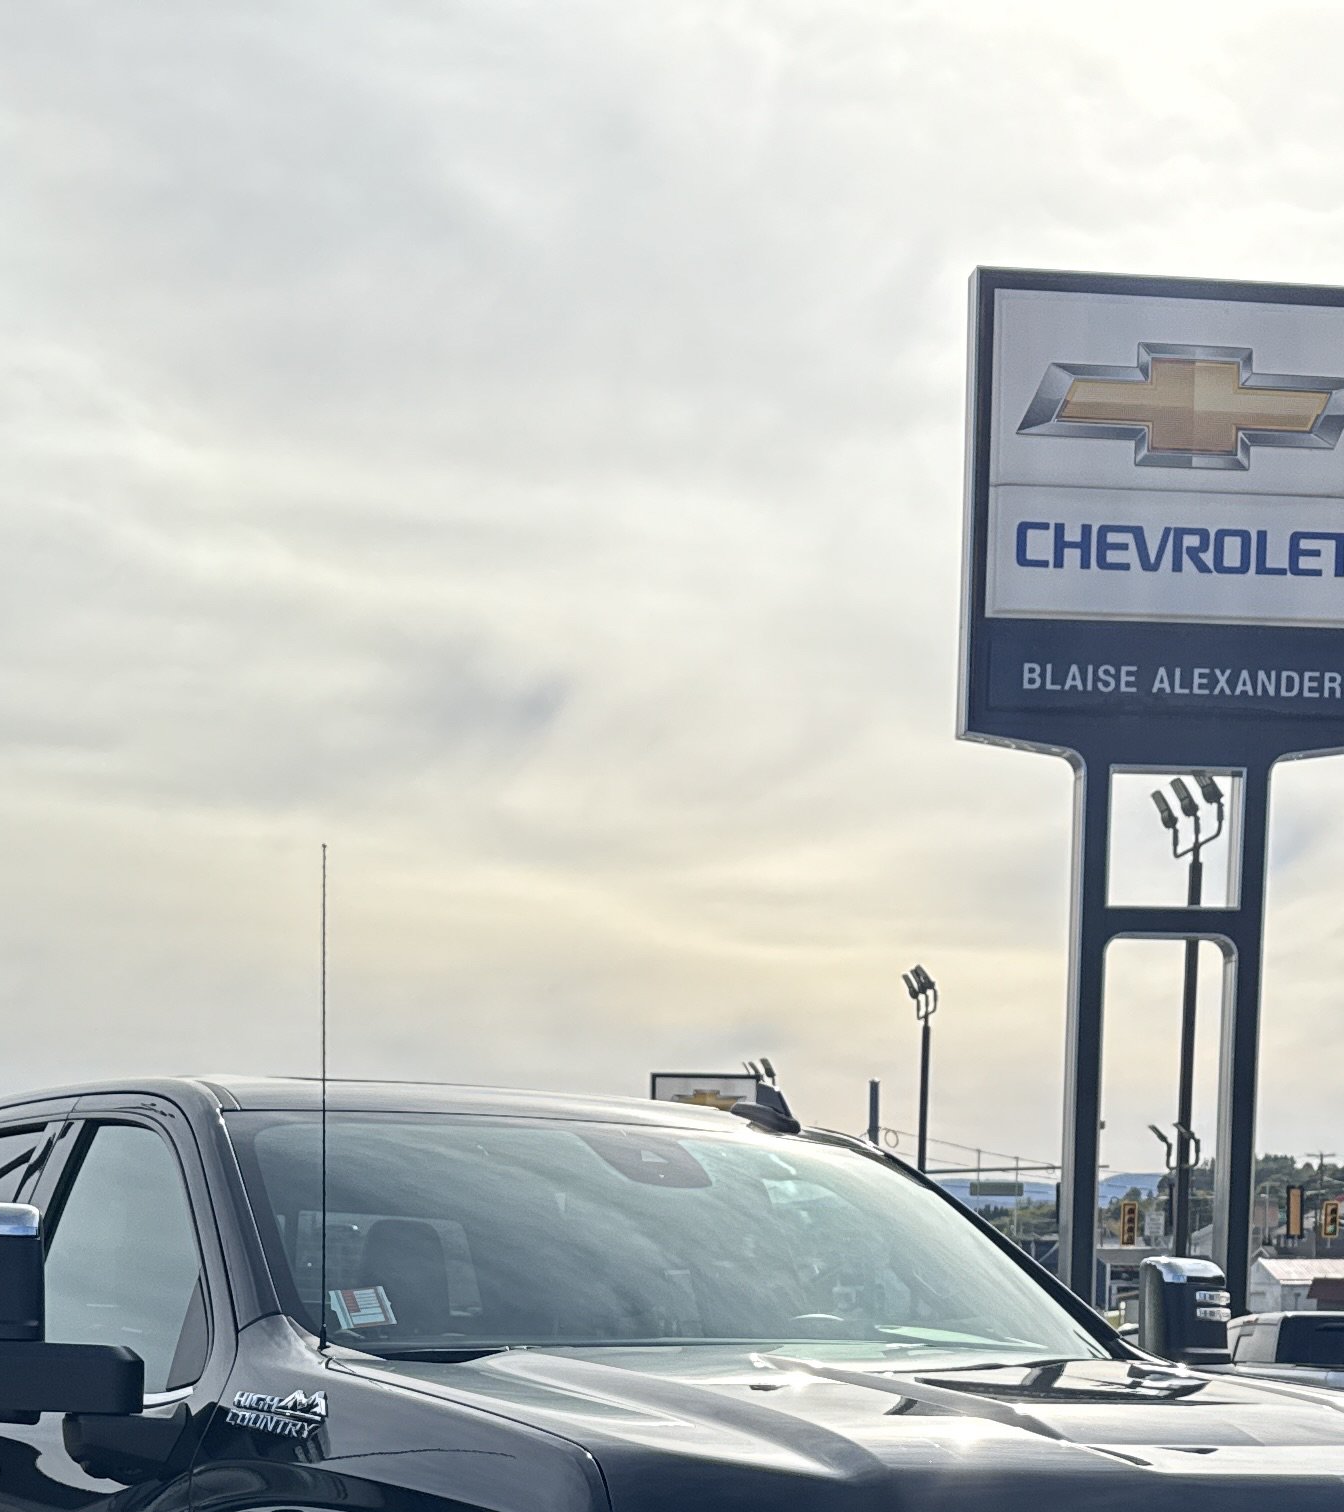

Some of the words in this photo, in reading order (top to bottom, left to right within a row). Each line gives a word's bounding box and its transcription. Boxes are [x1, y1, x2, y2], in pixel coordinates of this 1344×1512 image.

[1022, 662, 1138, 693] BLAISE
[1151, 666, 1343, 699] ALEXANDER
[233, 1391, 280, 1412] HIGH
[225, 1409, 321, 1438] COUNTRY
